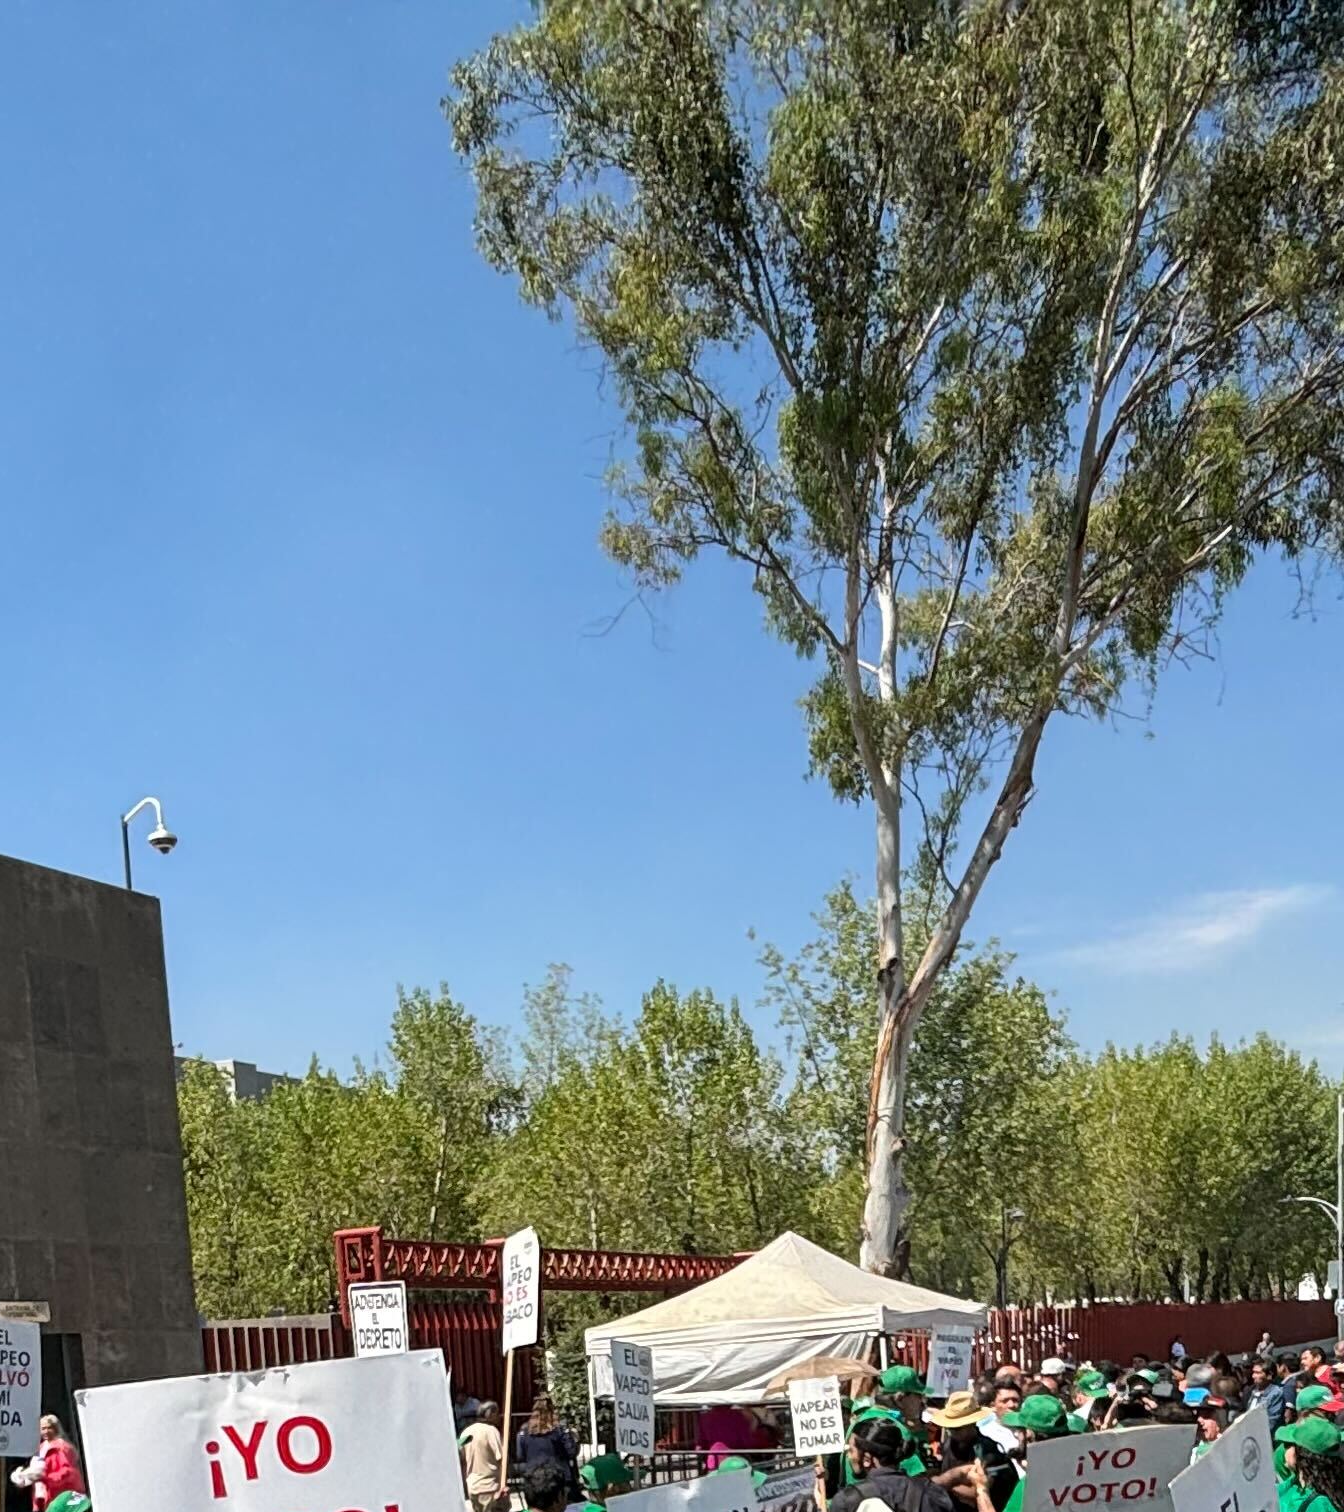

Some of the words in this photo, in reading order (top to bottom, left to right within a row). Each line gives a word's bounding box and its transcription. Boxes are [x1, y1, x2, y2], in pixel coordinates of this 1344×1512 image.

[516, 1287, 528, 1301] ES
[359, 1328, 402, 1349] DECRETO
[624, 1349, 639, 1367] EL
[616, 1373, 650, 1396] VAPEO
[617, 1401, 650, 1422] SALVA
[793, 1398, 838, 1416] VAPEAR
[800, 1418, 816, 1431] NO
[820, 1416, 836, 1429] ES
[618, 1429, 650, 1449] VIDAS
[799, 1433, 841, 1449] FUMAR
[205, 1415, 333, 1499] ¡YO
[1076, 1447, 1136, 1477] ¡YO
[1049, 1477, 1157, 1507] VOTO!
